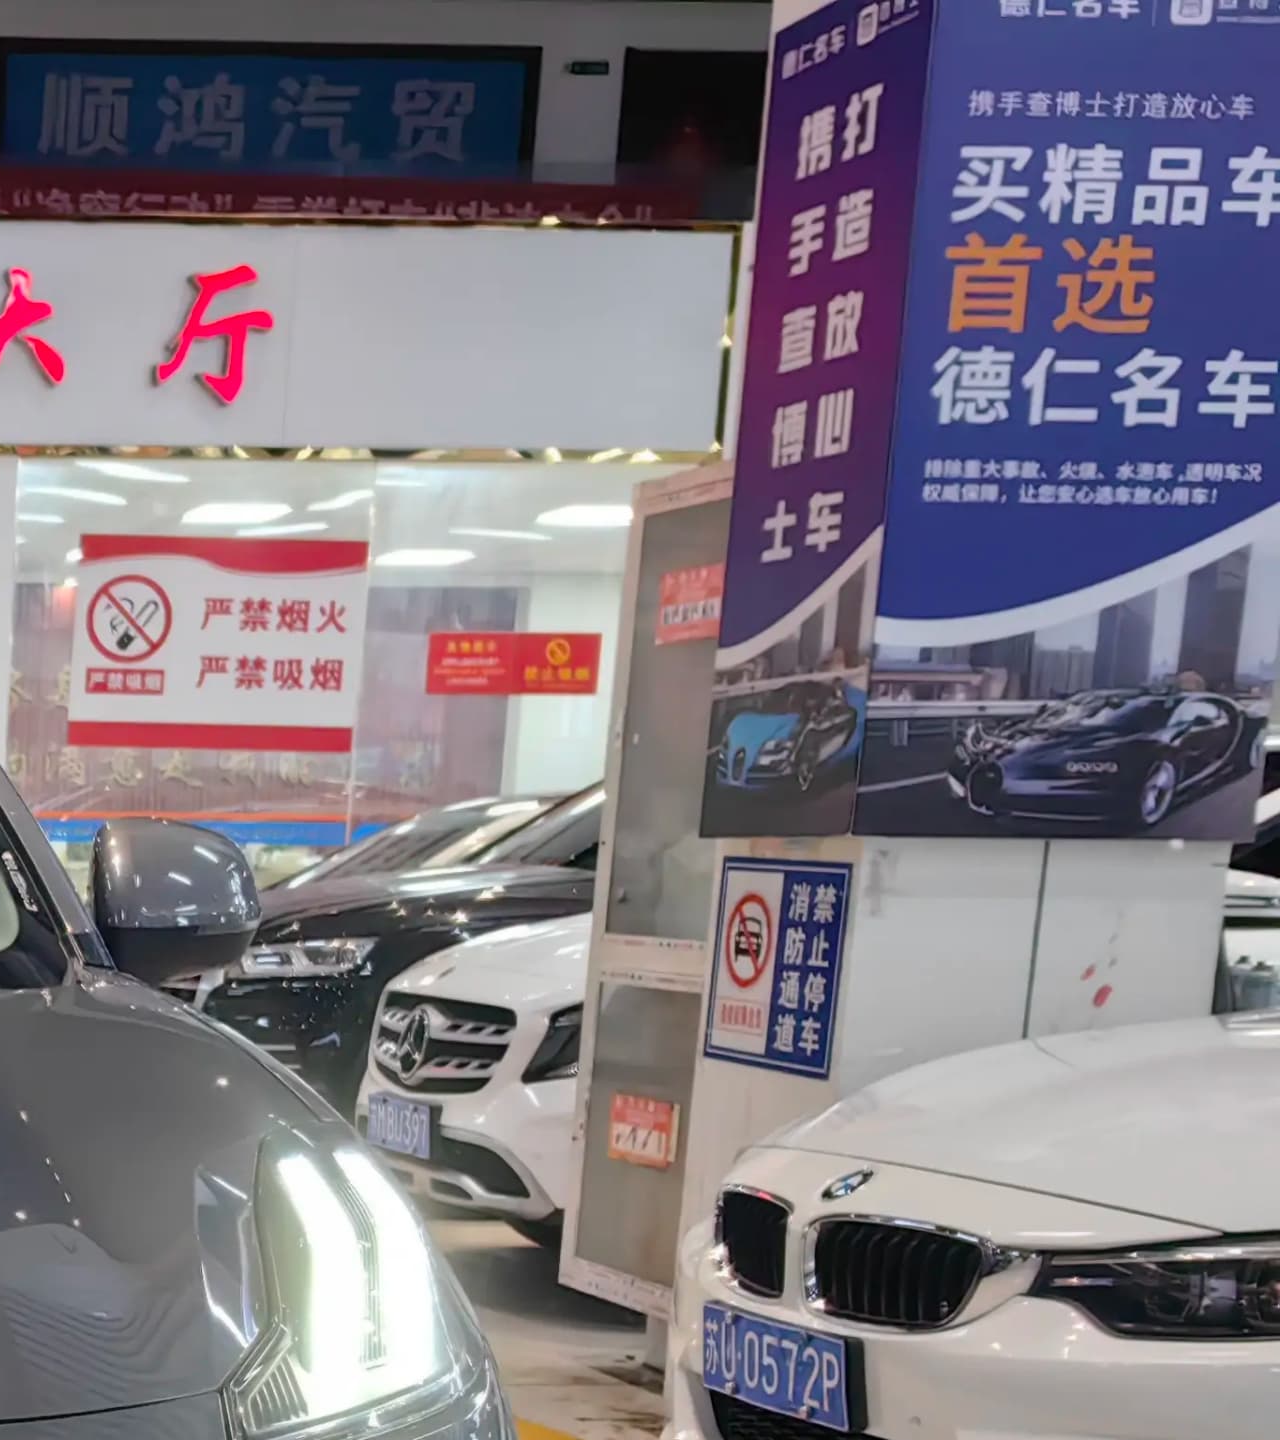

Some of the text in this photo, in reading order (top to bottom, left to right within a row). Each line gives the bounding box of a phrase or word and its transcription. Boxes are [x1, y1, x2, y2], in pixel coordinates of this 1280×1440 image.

[37, 73, 476, 162] 顺鸿汽贸
[967, 88, 1256, 121] 携手查博士打造放心车
[949, 144, 1280, 228] 买精品车
[805, 82, 885, 554] 打造放心车
[943, 234, 1157, 335] 首选
[930, 346, 1280, 430] 德仁名车
[199, 595, 349, 636] 严禁烟火
[86, 671, 164, 693] 严禁吸烟
[195, 653, 346, 693] 严禁吸烟
[773, 881, 812, 1054] 消防通道
[797, 882, 838, 1057] 禁止停车
